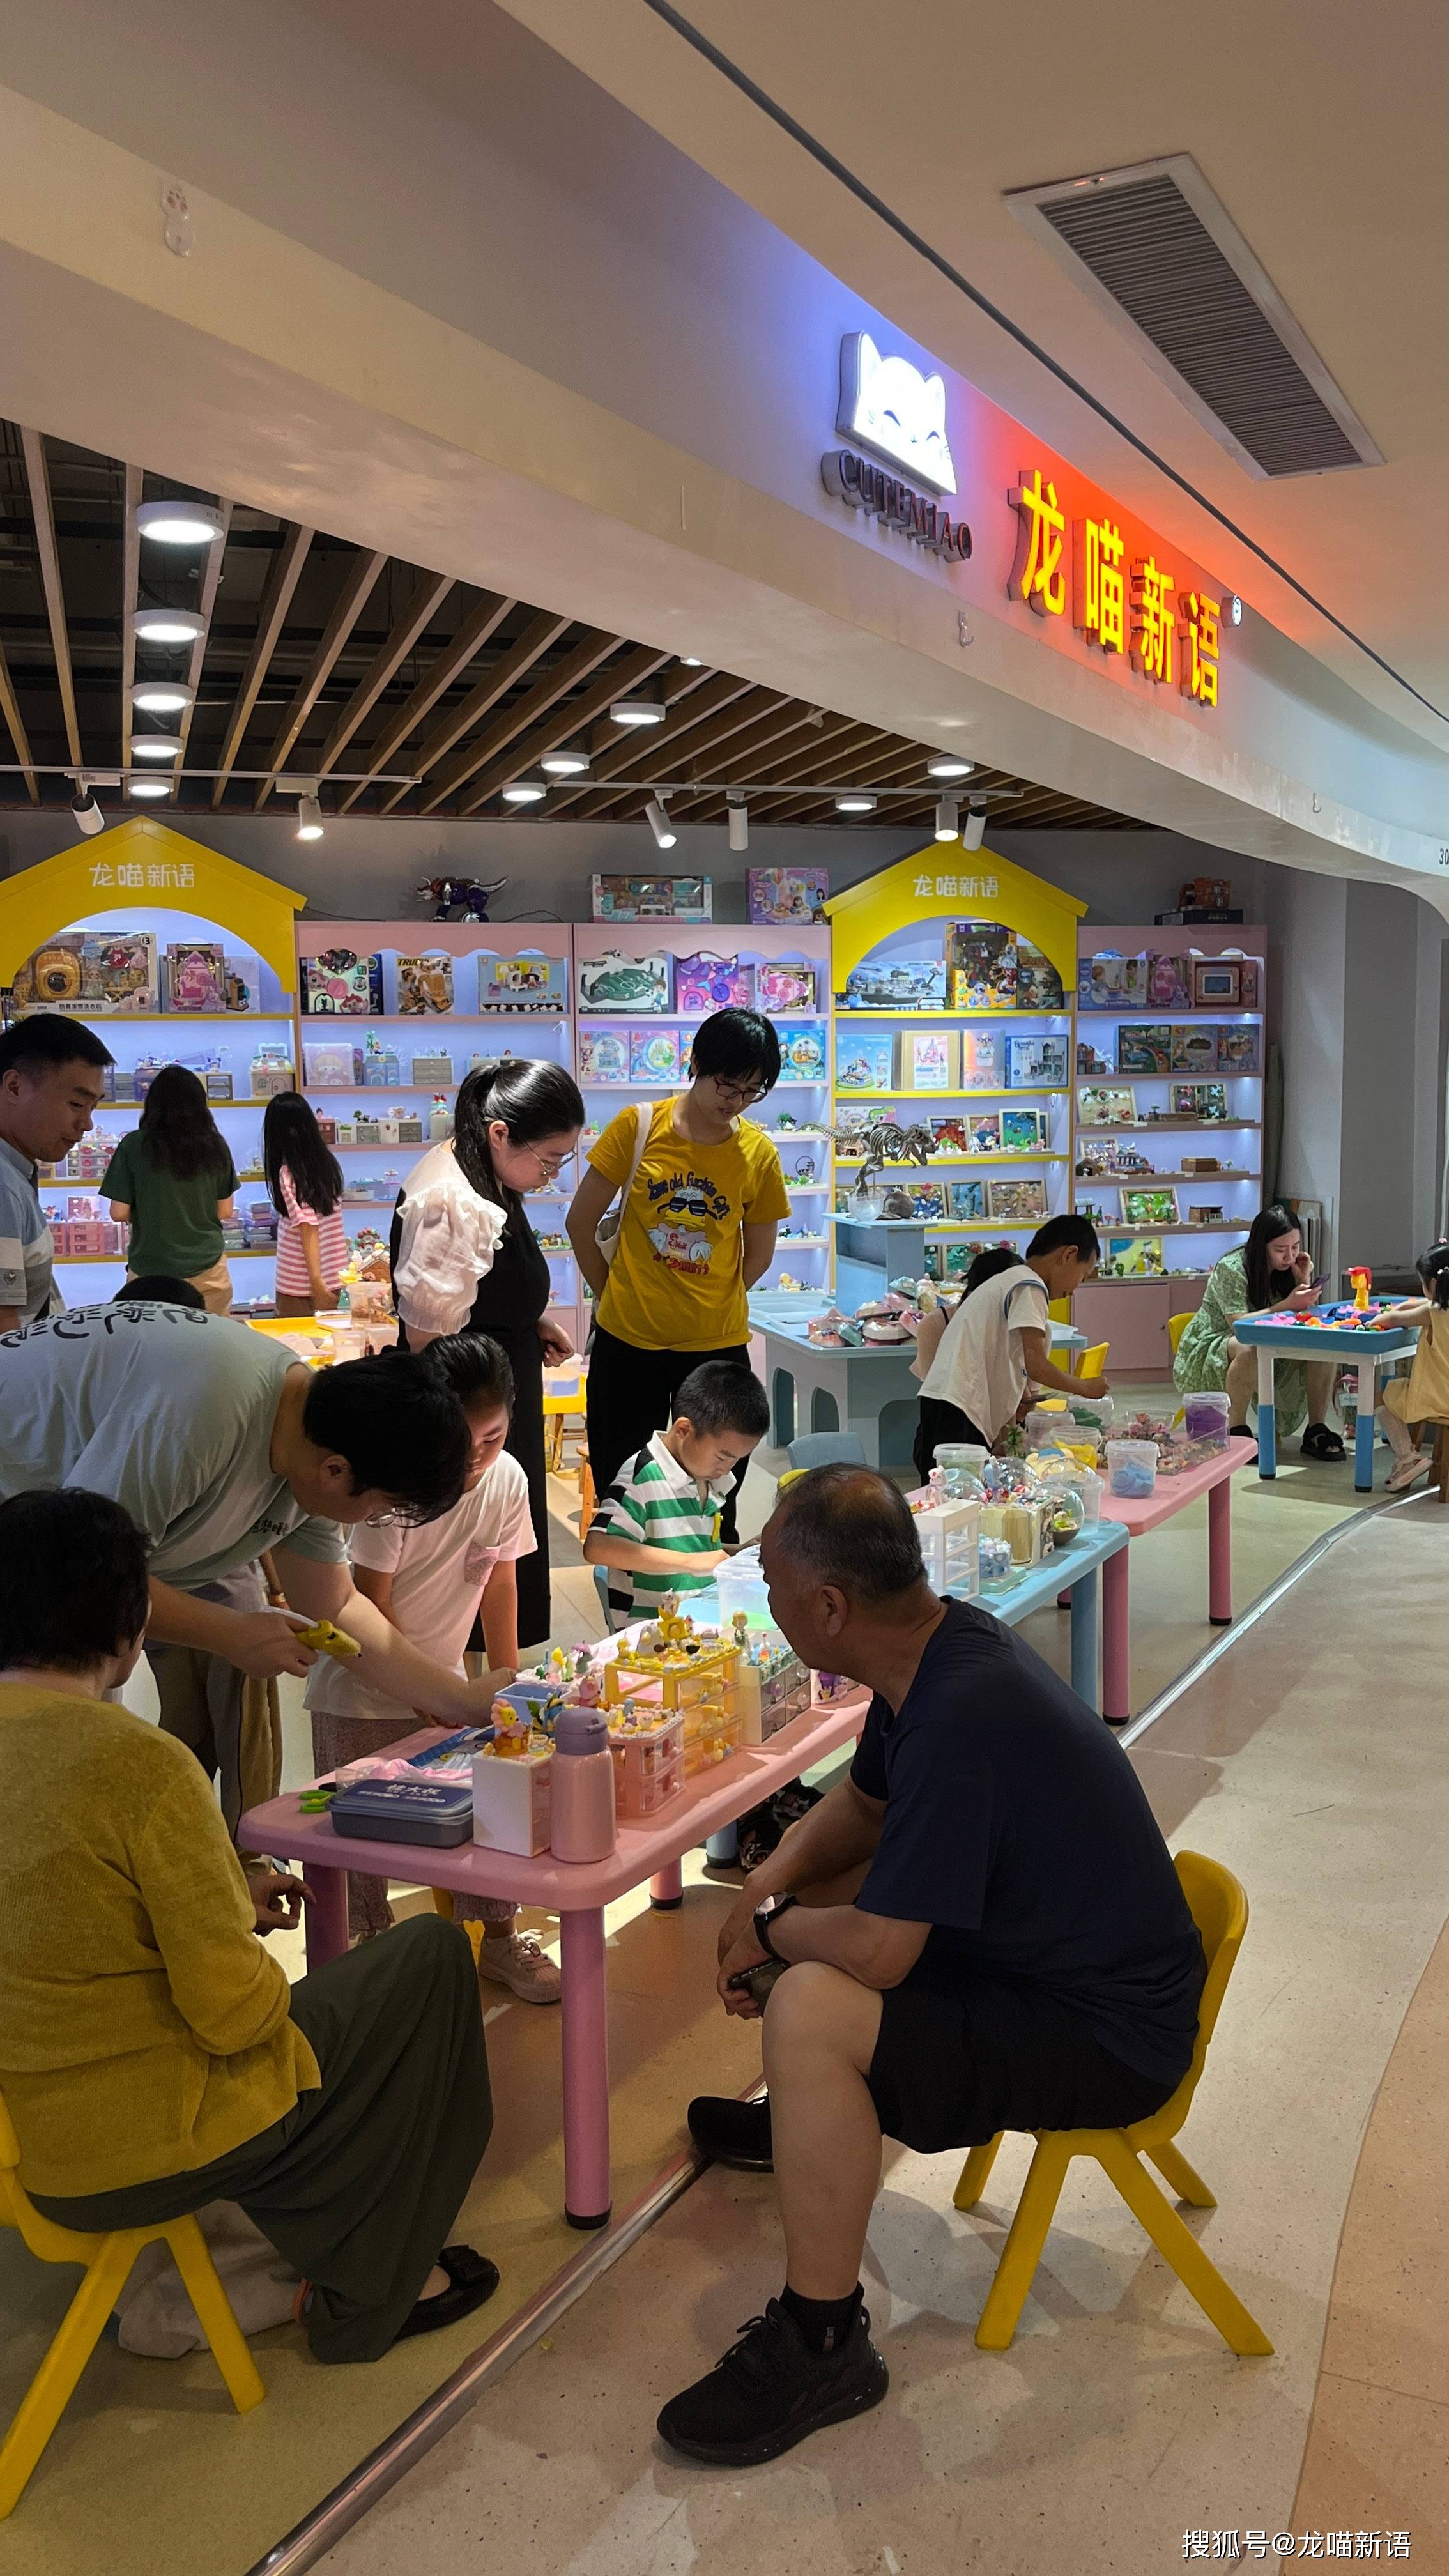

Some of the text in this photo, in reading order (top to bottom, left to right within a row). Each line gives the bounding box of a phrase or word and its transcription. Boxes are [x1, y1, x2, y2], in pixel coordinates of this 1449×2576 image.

[823, 449, 973, 562] CUTEMIAO
[1015, 469, 1221, 707] 龙喵新语
[89, 861, 195, 887] 龙喵新语
[913, 873, 999, 898] 龙喵新语
